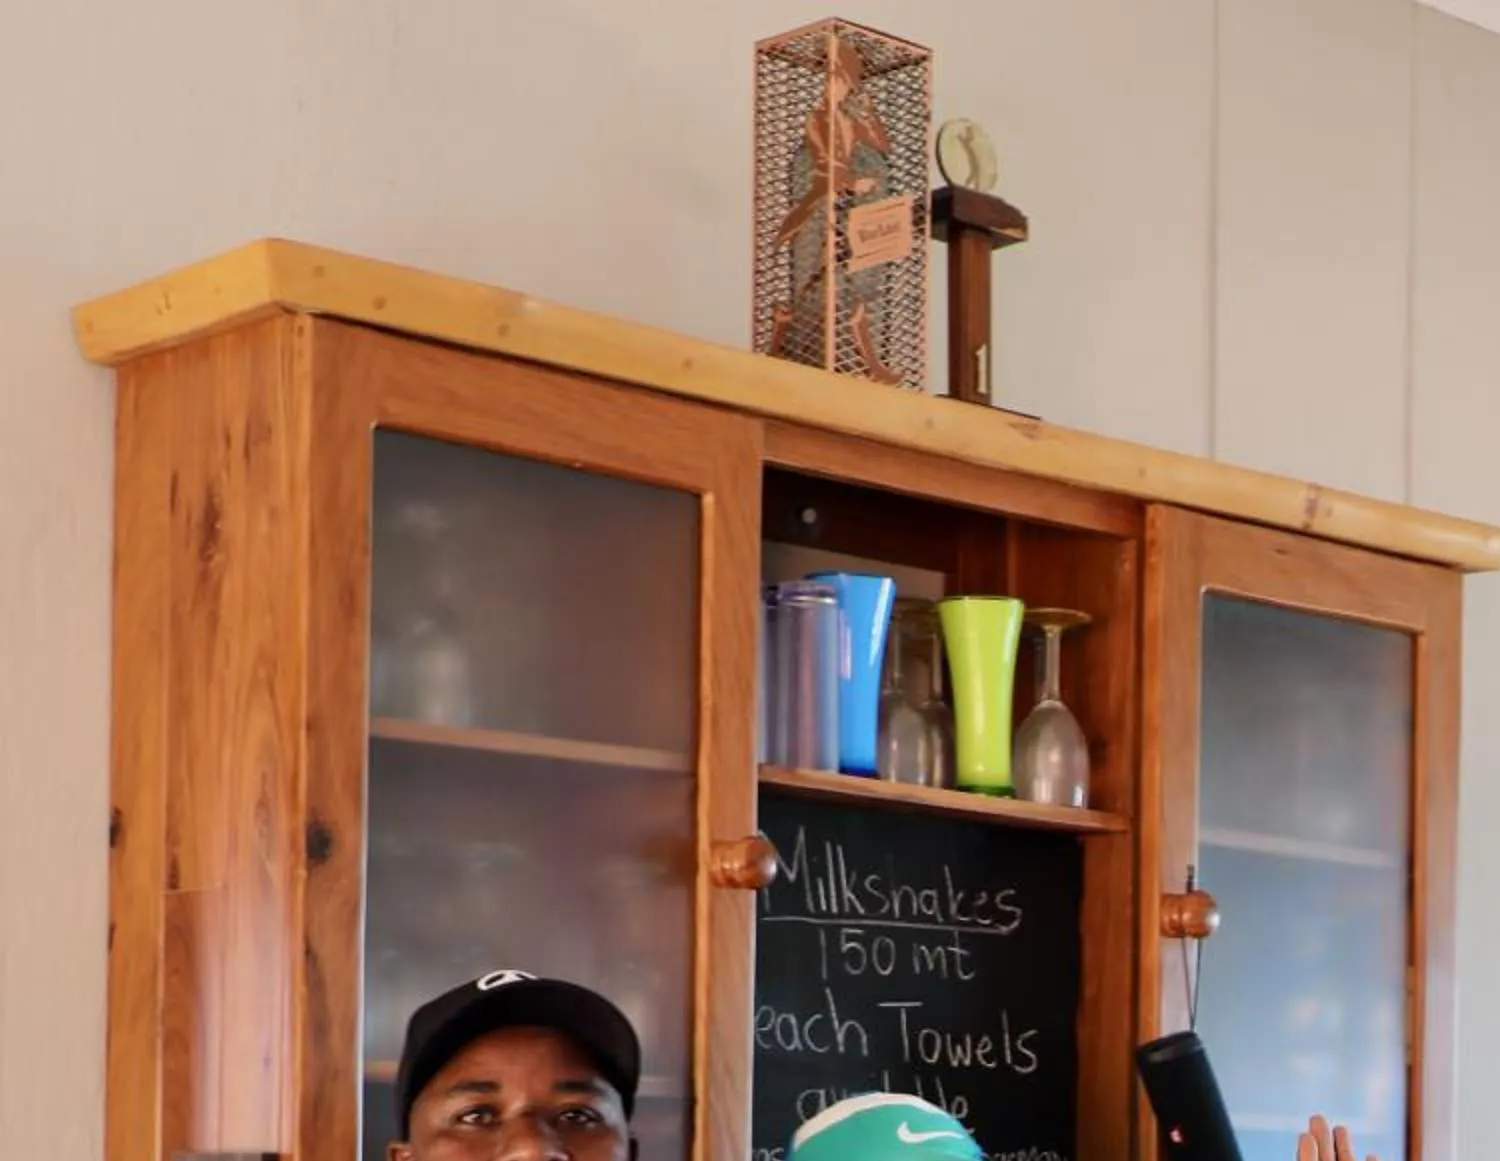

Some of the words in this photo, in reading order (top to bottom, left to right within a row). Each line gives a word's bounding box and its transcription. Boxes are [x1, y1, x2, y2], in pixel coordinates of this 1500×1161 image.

[758, 825, 1023, 932] Milkshakes
[819, 927, 897, 980] 150
[911, 930, 976, 980] mt
[754, 986, 868, 1057] each
[877, 1001, 1038, 1074] Towels
